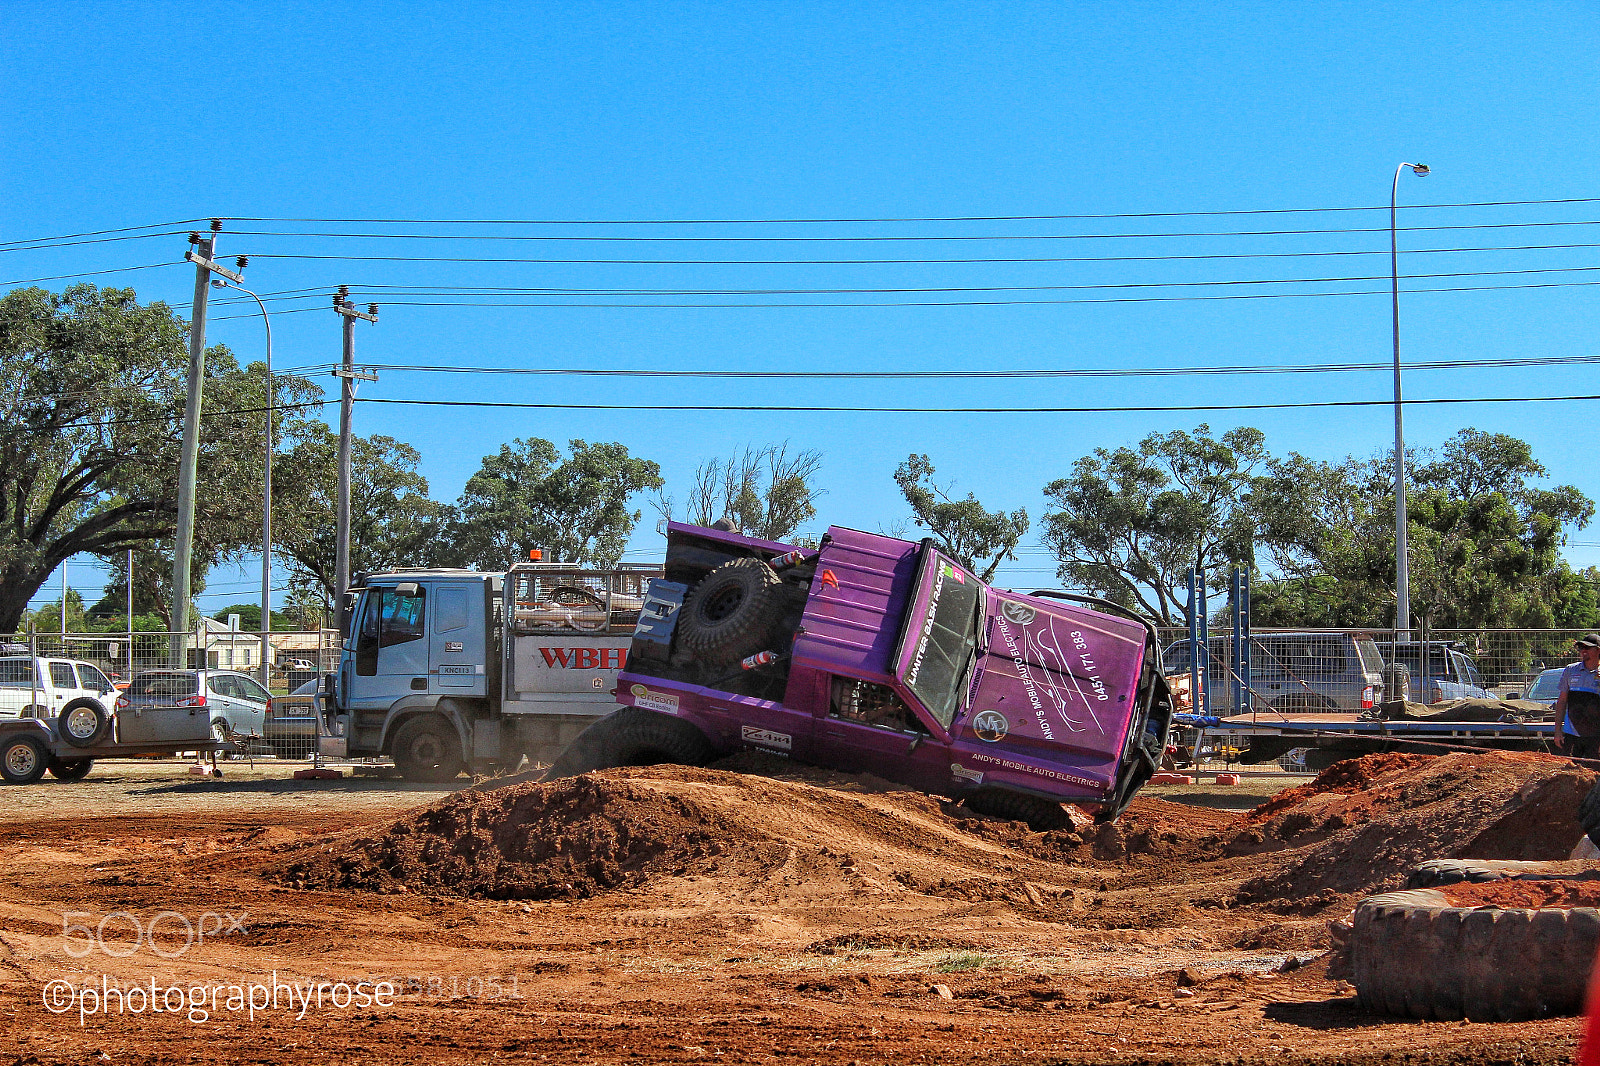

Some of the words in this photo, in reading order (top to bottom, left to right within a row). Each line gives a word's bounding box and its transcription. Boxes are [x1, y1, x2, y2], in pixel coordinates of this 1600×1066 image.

[908, 635, 929, 686] LIMITER
[923, 600, 938, 635] BASH
[933, 559, 947, 601] RACING
[995, 615, 1021, 657] ELECTRICS
[1070, 630, 1087, 650] 383
[538, 647, 629, 670] WBH
[1014, 657, 1030, 679] AUTO
[1080, 653, 1097, 672] 171
[1022, 679, 1043, 710] MOBILE
[1088, 675, 1109, 701] 0451
[1035, 710, 1055, 740] ANDY'S
[972, 753, 1001, 765] ANDY'S
[1002, 760, 1033, 773] MOBILE
[1033, 767, 1055, 778] AUTO
[1056, 772, 1100, 788] ELECTRICS
